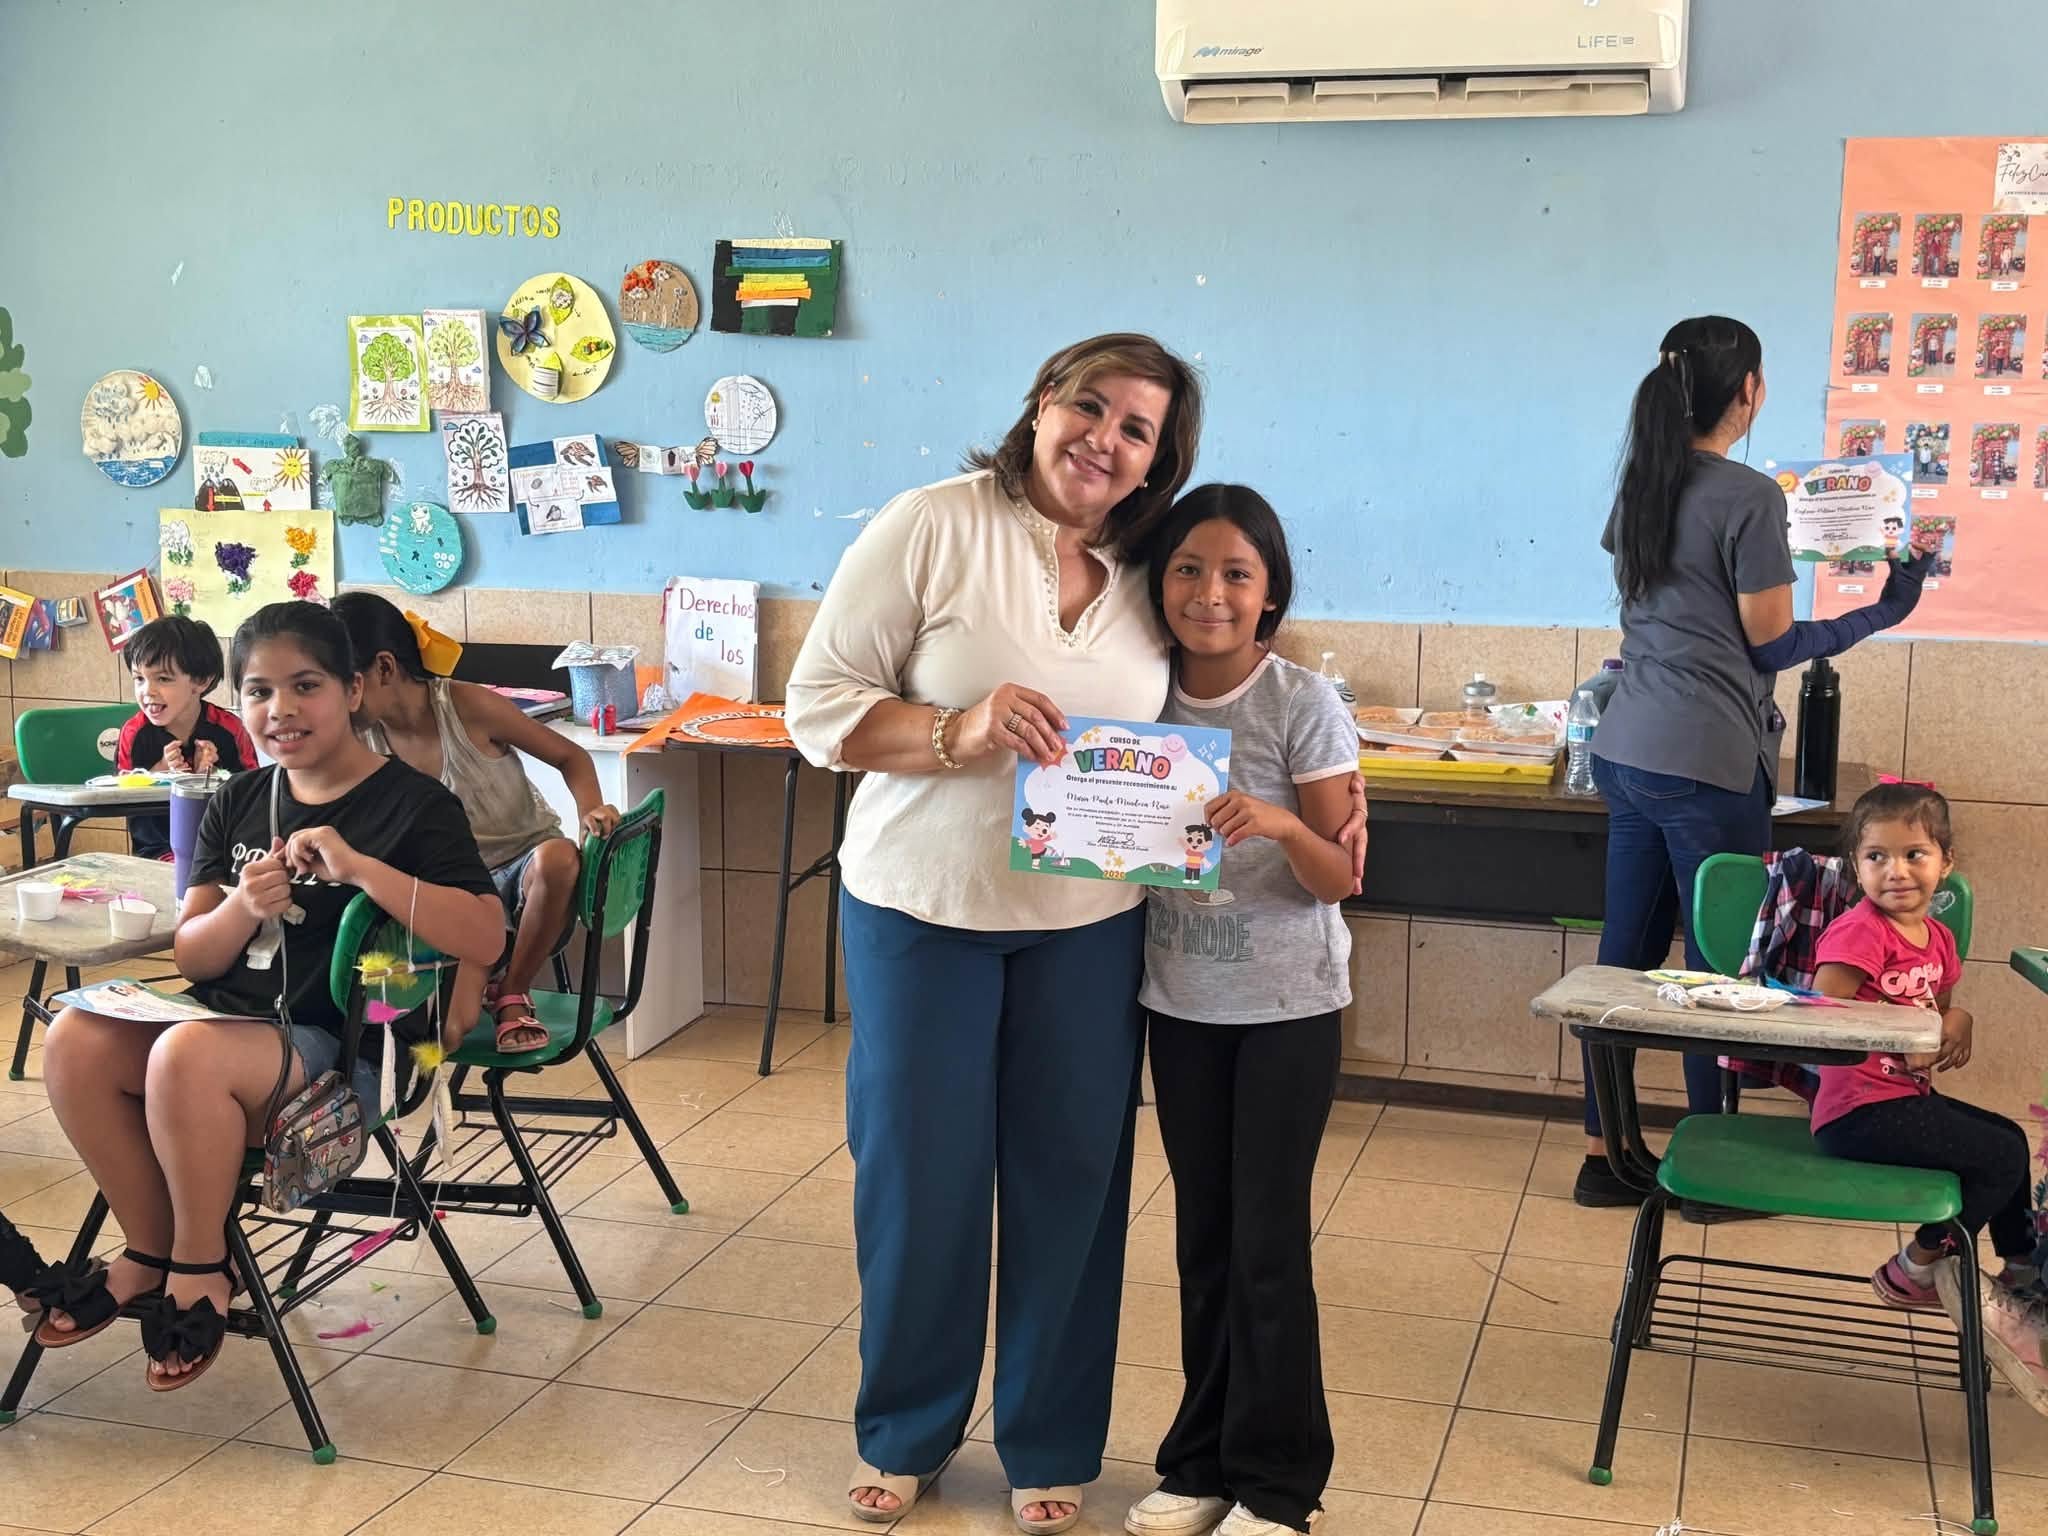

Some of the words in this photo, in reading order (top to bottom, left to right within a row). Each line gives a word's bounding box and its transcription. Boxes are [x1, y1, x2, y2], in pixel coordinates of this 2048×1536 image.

[1219, 46, 1263, 57] mirage
[387, 197, 561, 239] PRODUCTOS
[1804, 475, 1872, 496] VERANO
[680, 587, 754, 619] Derechos
[695, 619, 714, 641] de
[721, 639, 744, 665] los
[1109, 736, 1131, 745] CURSO
[1132, 738, 1141, 746] DE
[1073, 747, 1171, 780] VERANO
[1066, 774, 1088, 784] Otorga
[1095, 778, 1122, 787] presente
[1183, 911, 1254, 962] MODE
